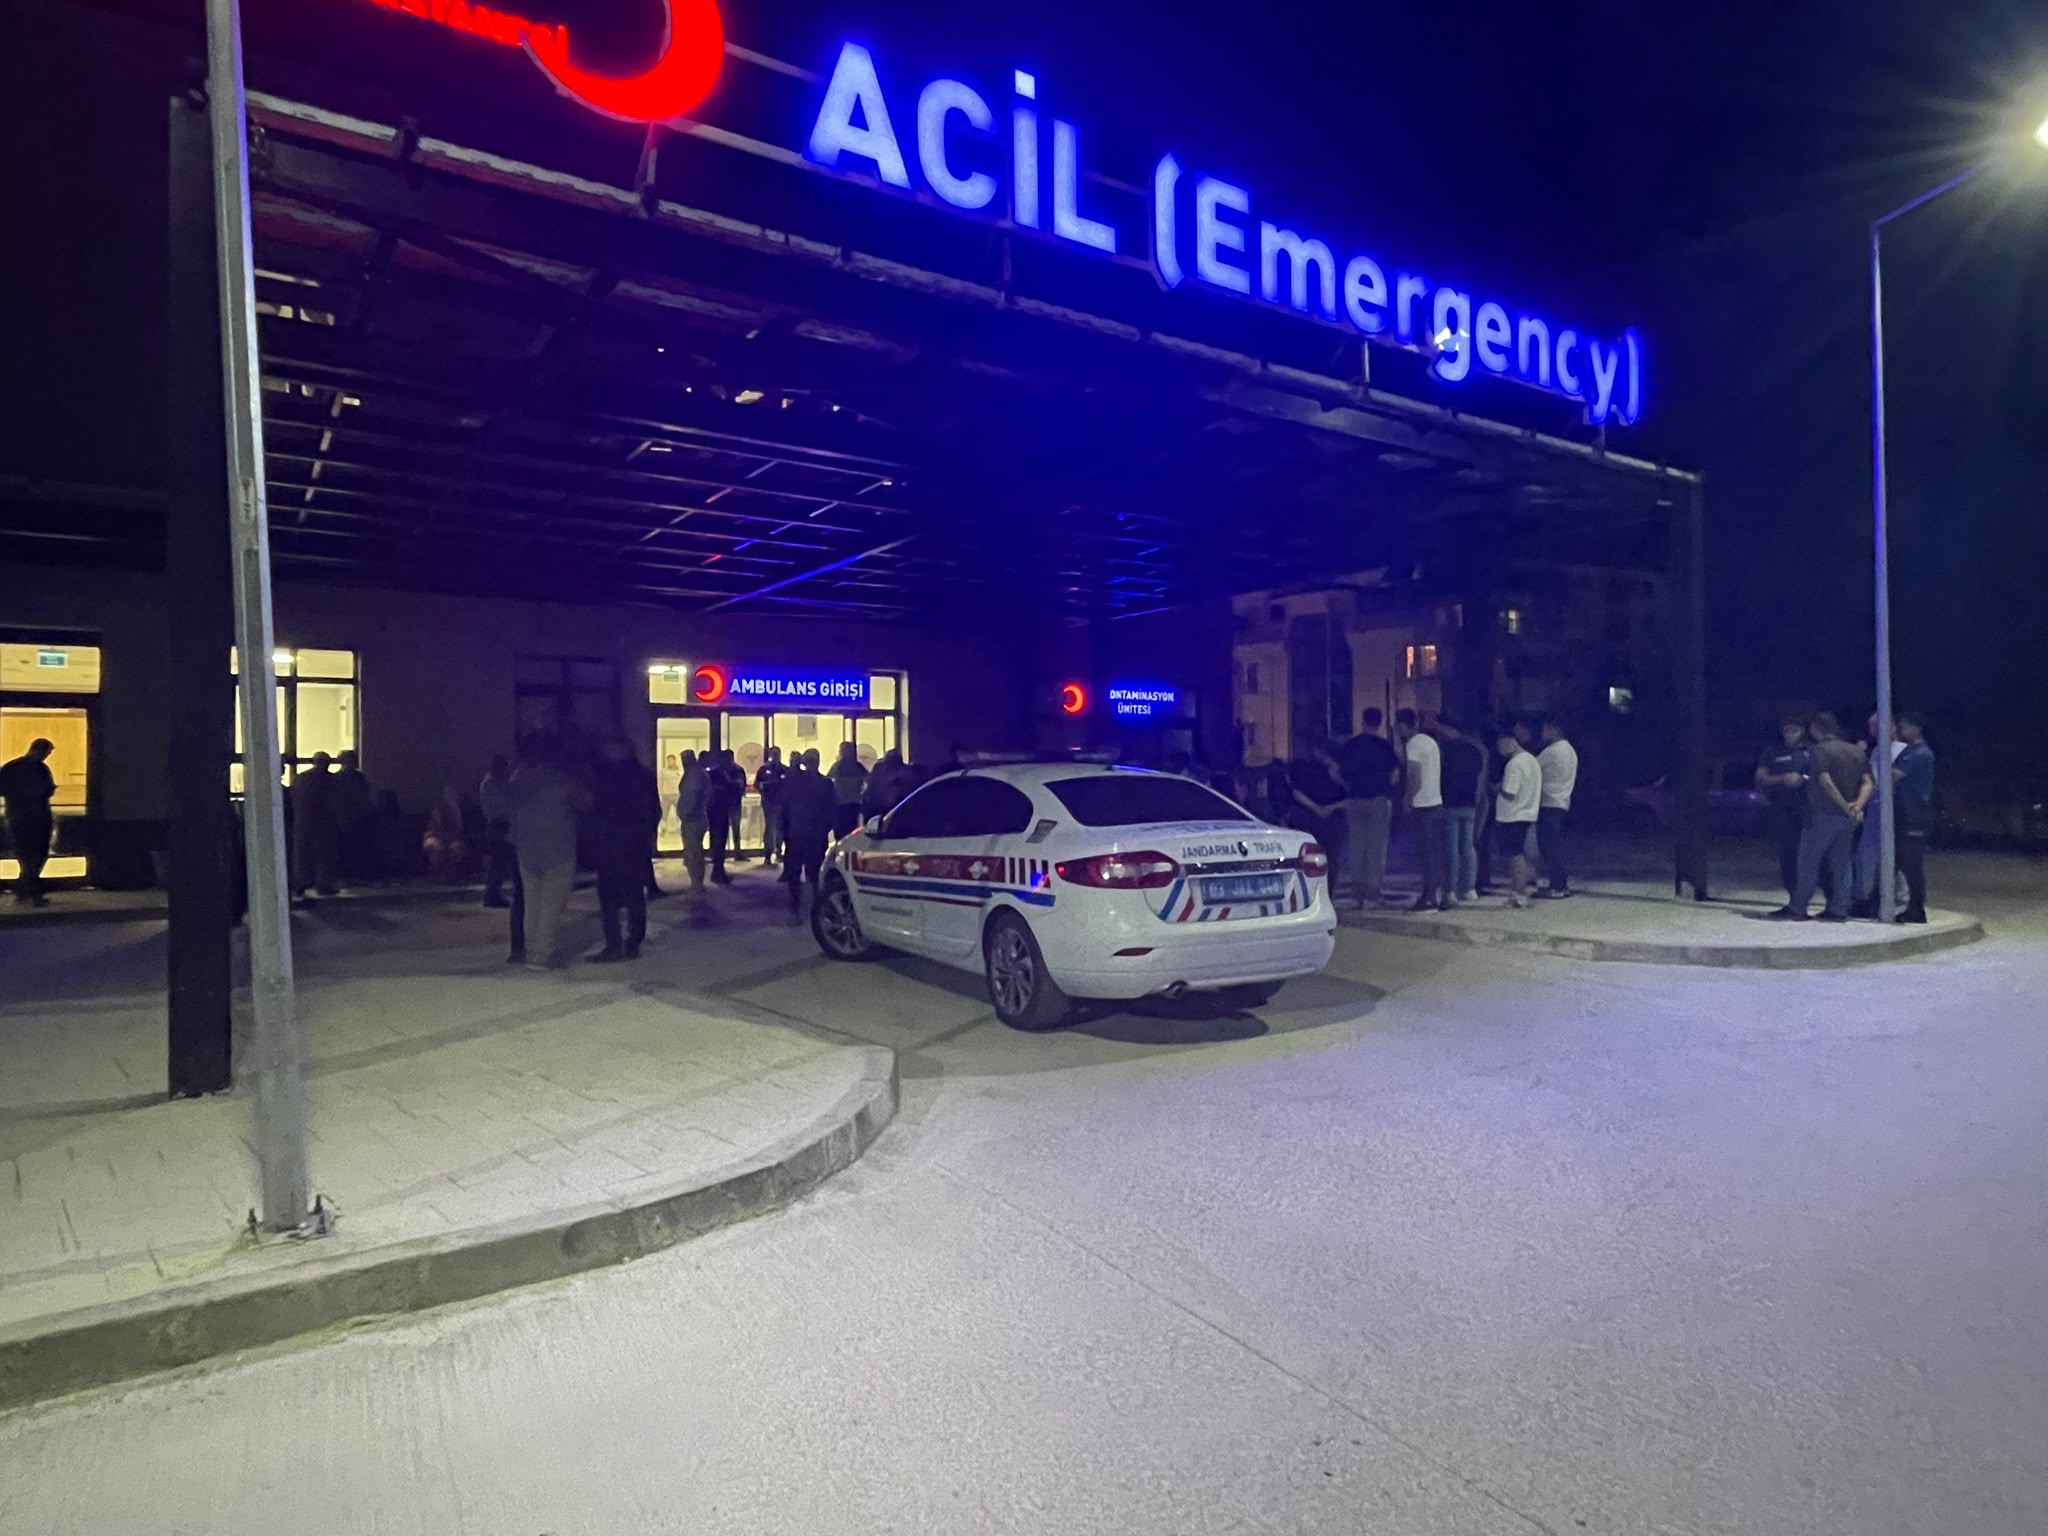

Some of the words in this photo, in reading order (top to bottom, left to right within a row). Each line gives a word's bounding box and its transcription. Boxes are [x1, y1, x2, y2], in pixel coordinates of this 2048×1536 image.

[806, 41, 1117, 255] ACİL
[1153, 152, 1641, 424] (Emergency)
[730, 678, 817, 696] AMBULANS
[819, 679, 863, 701] GİRİŞİ
[1181, 844, 1238, 859] JANDARMA
